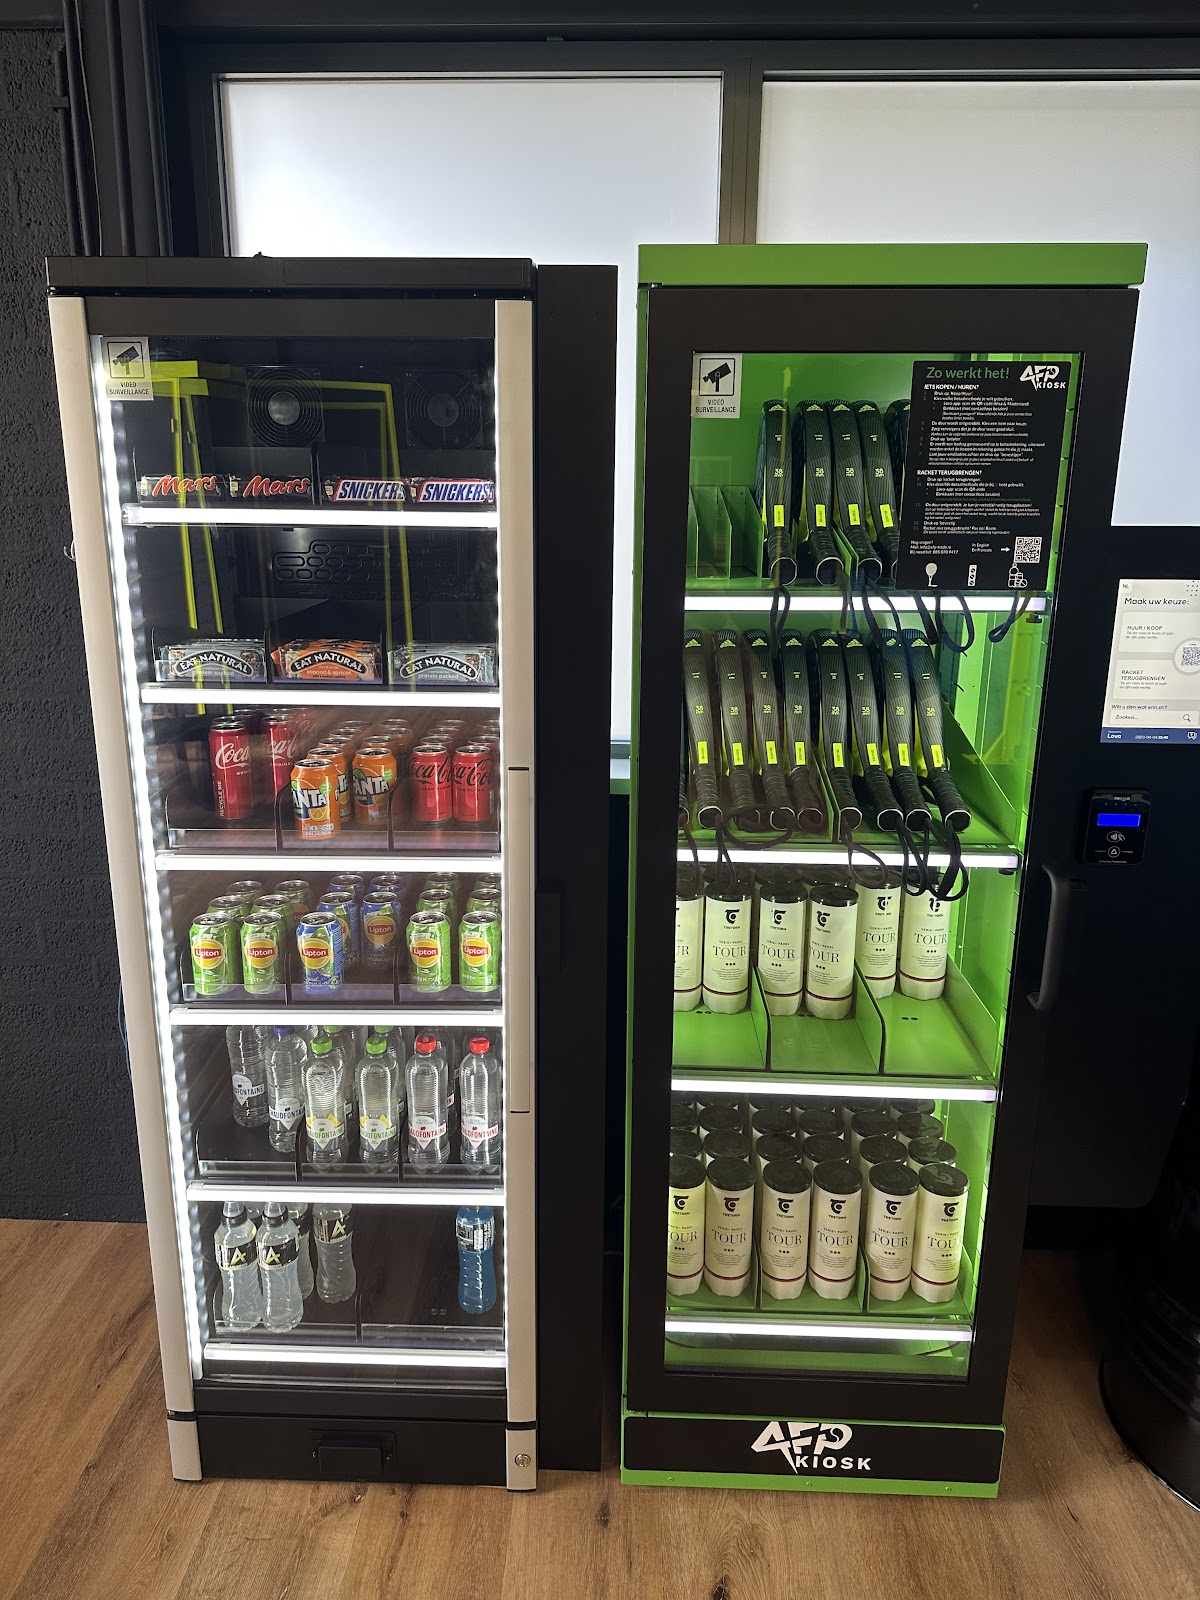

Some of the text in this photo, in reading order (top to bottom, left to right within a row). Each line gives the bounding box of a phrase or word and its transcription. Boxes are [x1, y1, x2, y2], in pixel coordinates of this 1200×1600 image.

[926, 367, 1009, 379] Zo werkt het!
[1036, 381, 1066, 389] KIOSK
[152, 474, 217, 497] Mars
[243, 475, 311, 498] Mars
[338, 481, 405, 500] SNICKERS
[423, 483, 490, 501] SNICKERS
[180, 653, 248, 673] EAT NATURAL
[294, 653, 362, 672] EAT NATURAL
[405, 657, 472, 676] EAT NATURAL
[862, 932, 896, 944] TOUR
[914, 933, 946, 945] TOUR
[464, 946, 487, 955] Lipton
[712, 946, 746, 958] TOUR
[762, 944, 795, 959] TOUR
[712, 1228, 746, 1244] TOUR
[766, 1230, 802, 1246] TOUR
[818, 1230, 853, 1246] TOUR
[872, 1230, 908, 1248] TOUR
[751, 1421, 852, 1466] AFP
[796, 1456, 872, 1470] KIOSK
